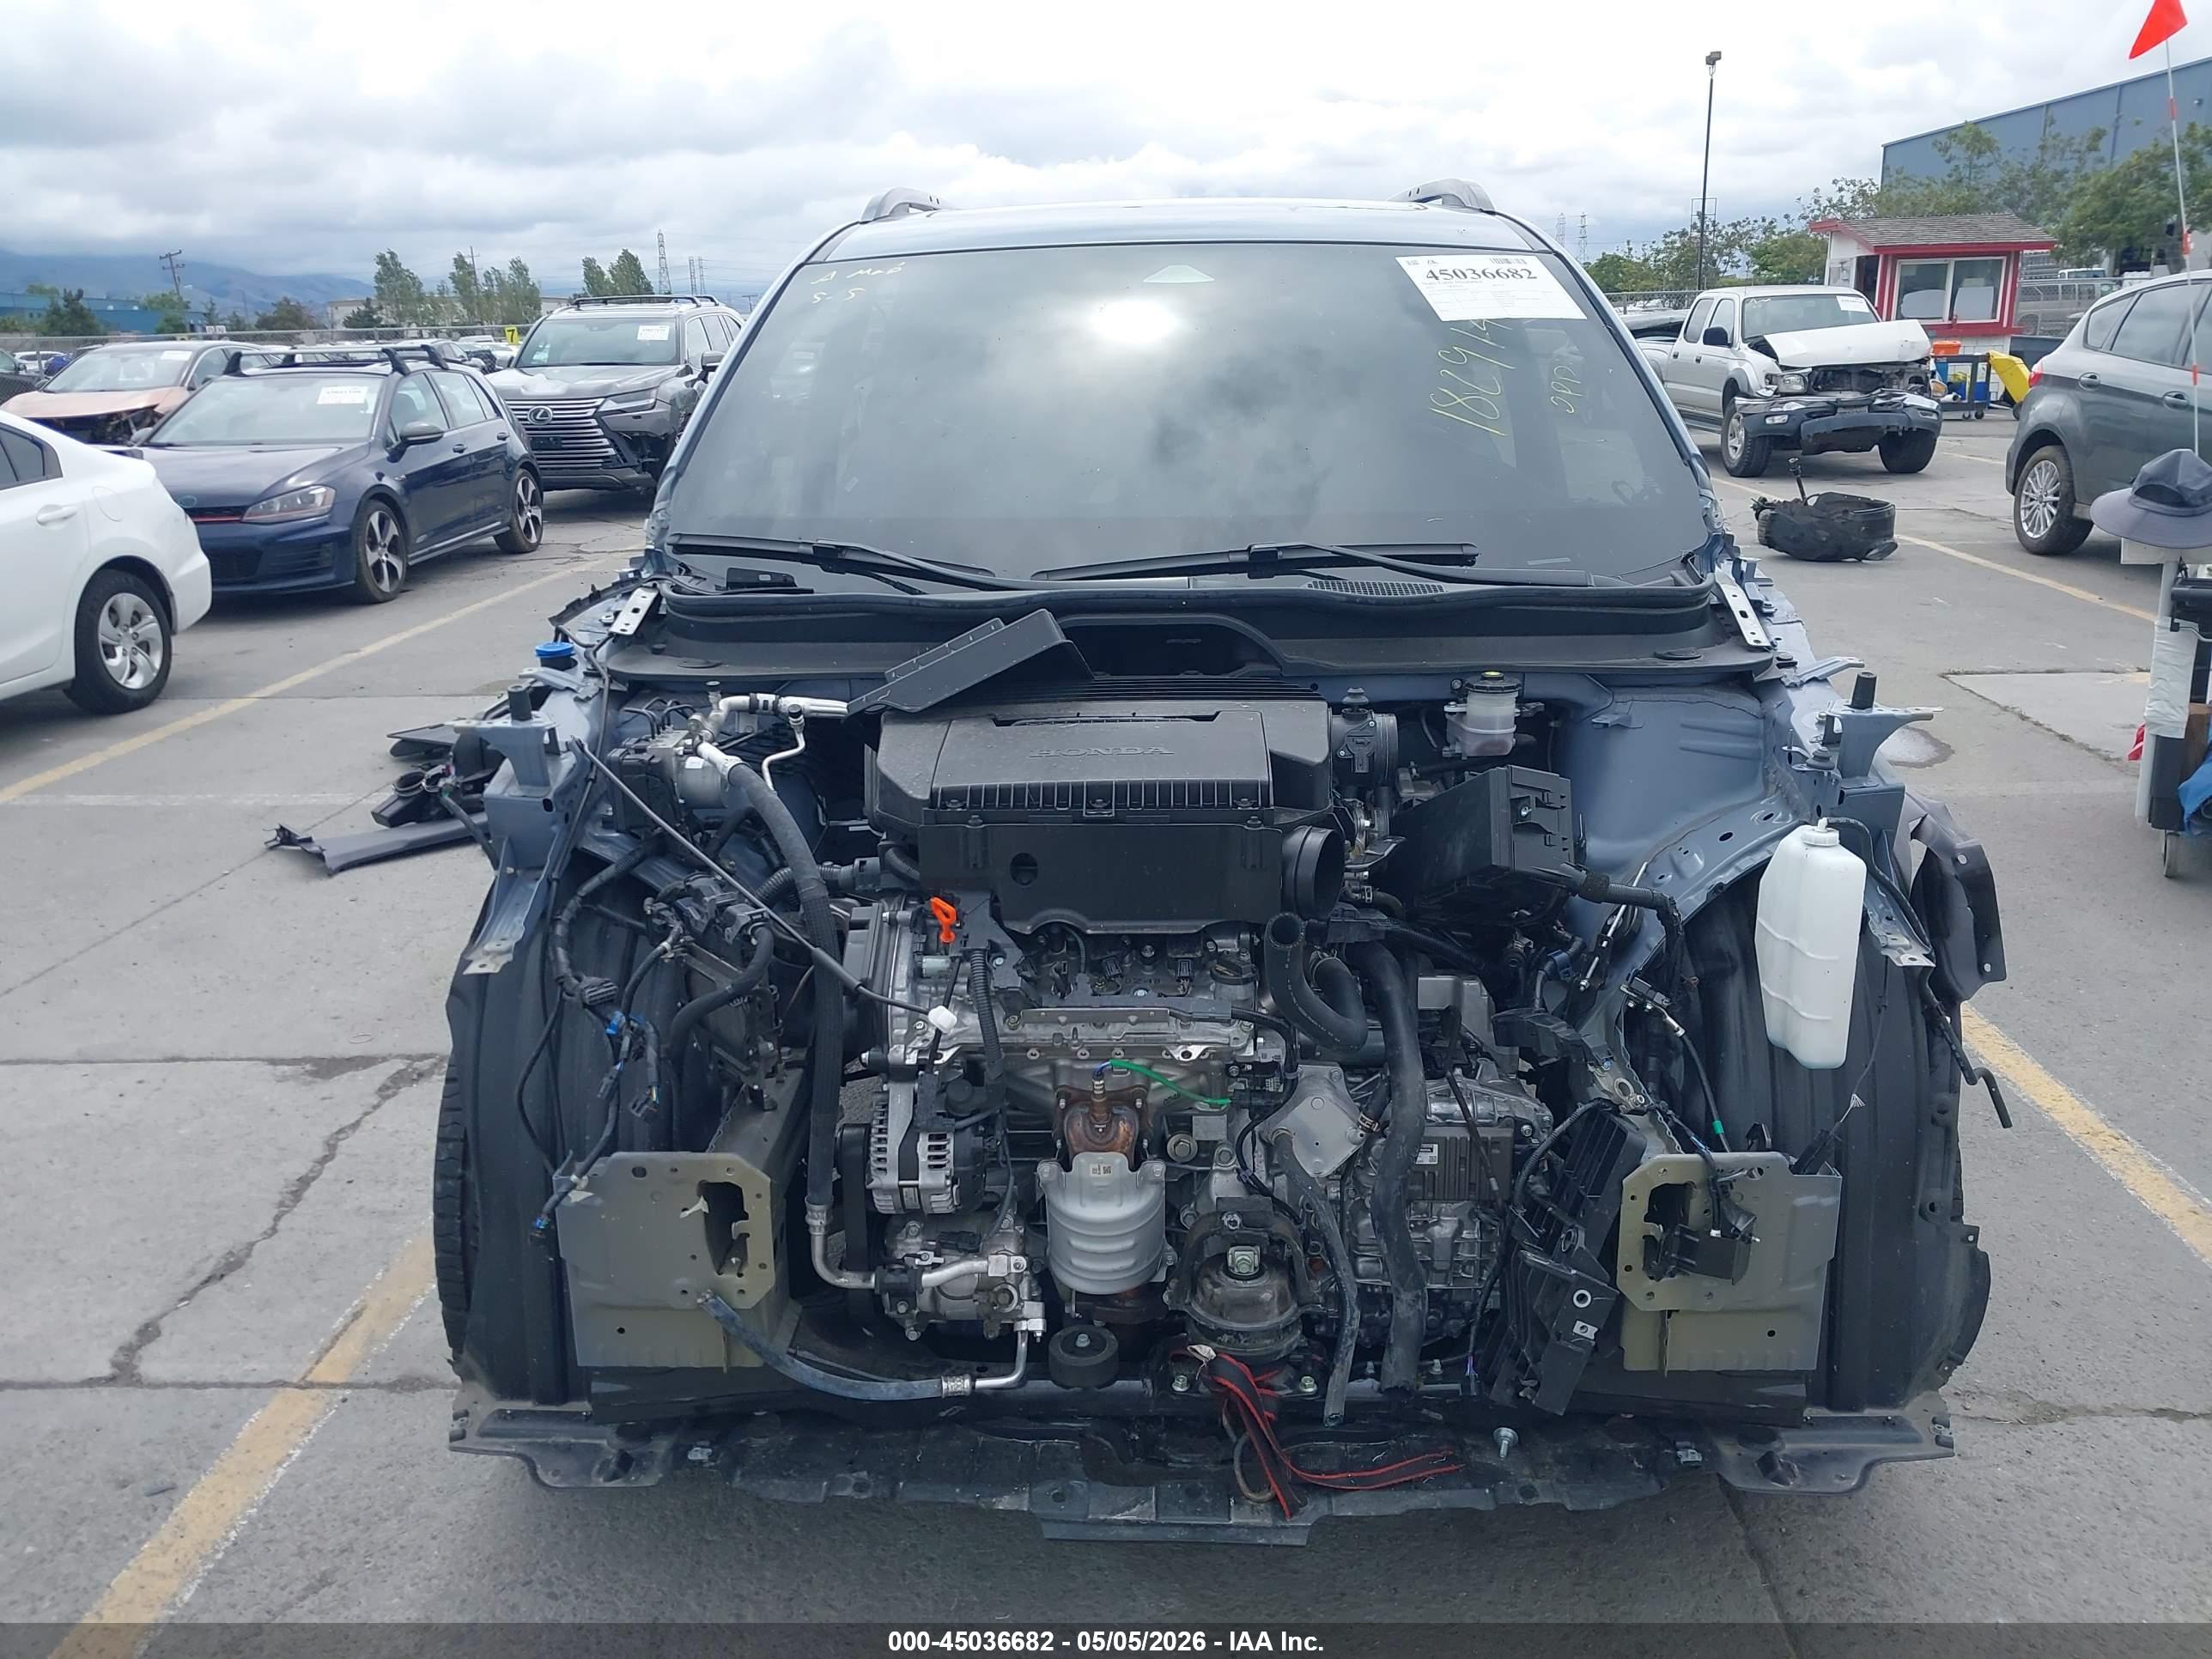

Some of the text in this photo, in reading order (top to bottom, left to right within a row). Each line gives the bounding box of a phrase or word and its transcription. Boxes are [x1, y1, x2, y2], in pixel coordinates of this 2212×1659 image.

[1425, 267, 1537, 282] 45036682
[507, 329, 516, 343] 7
[1030, 745, 1176, 758] HONDA
